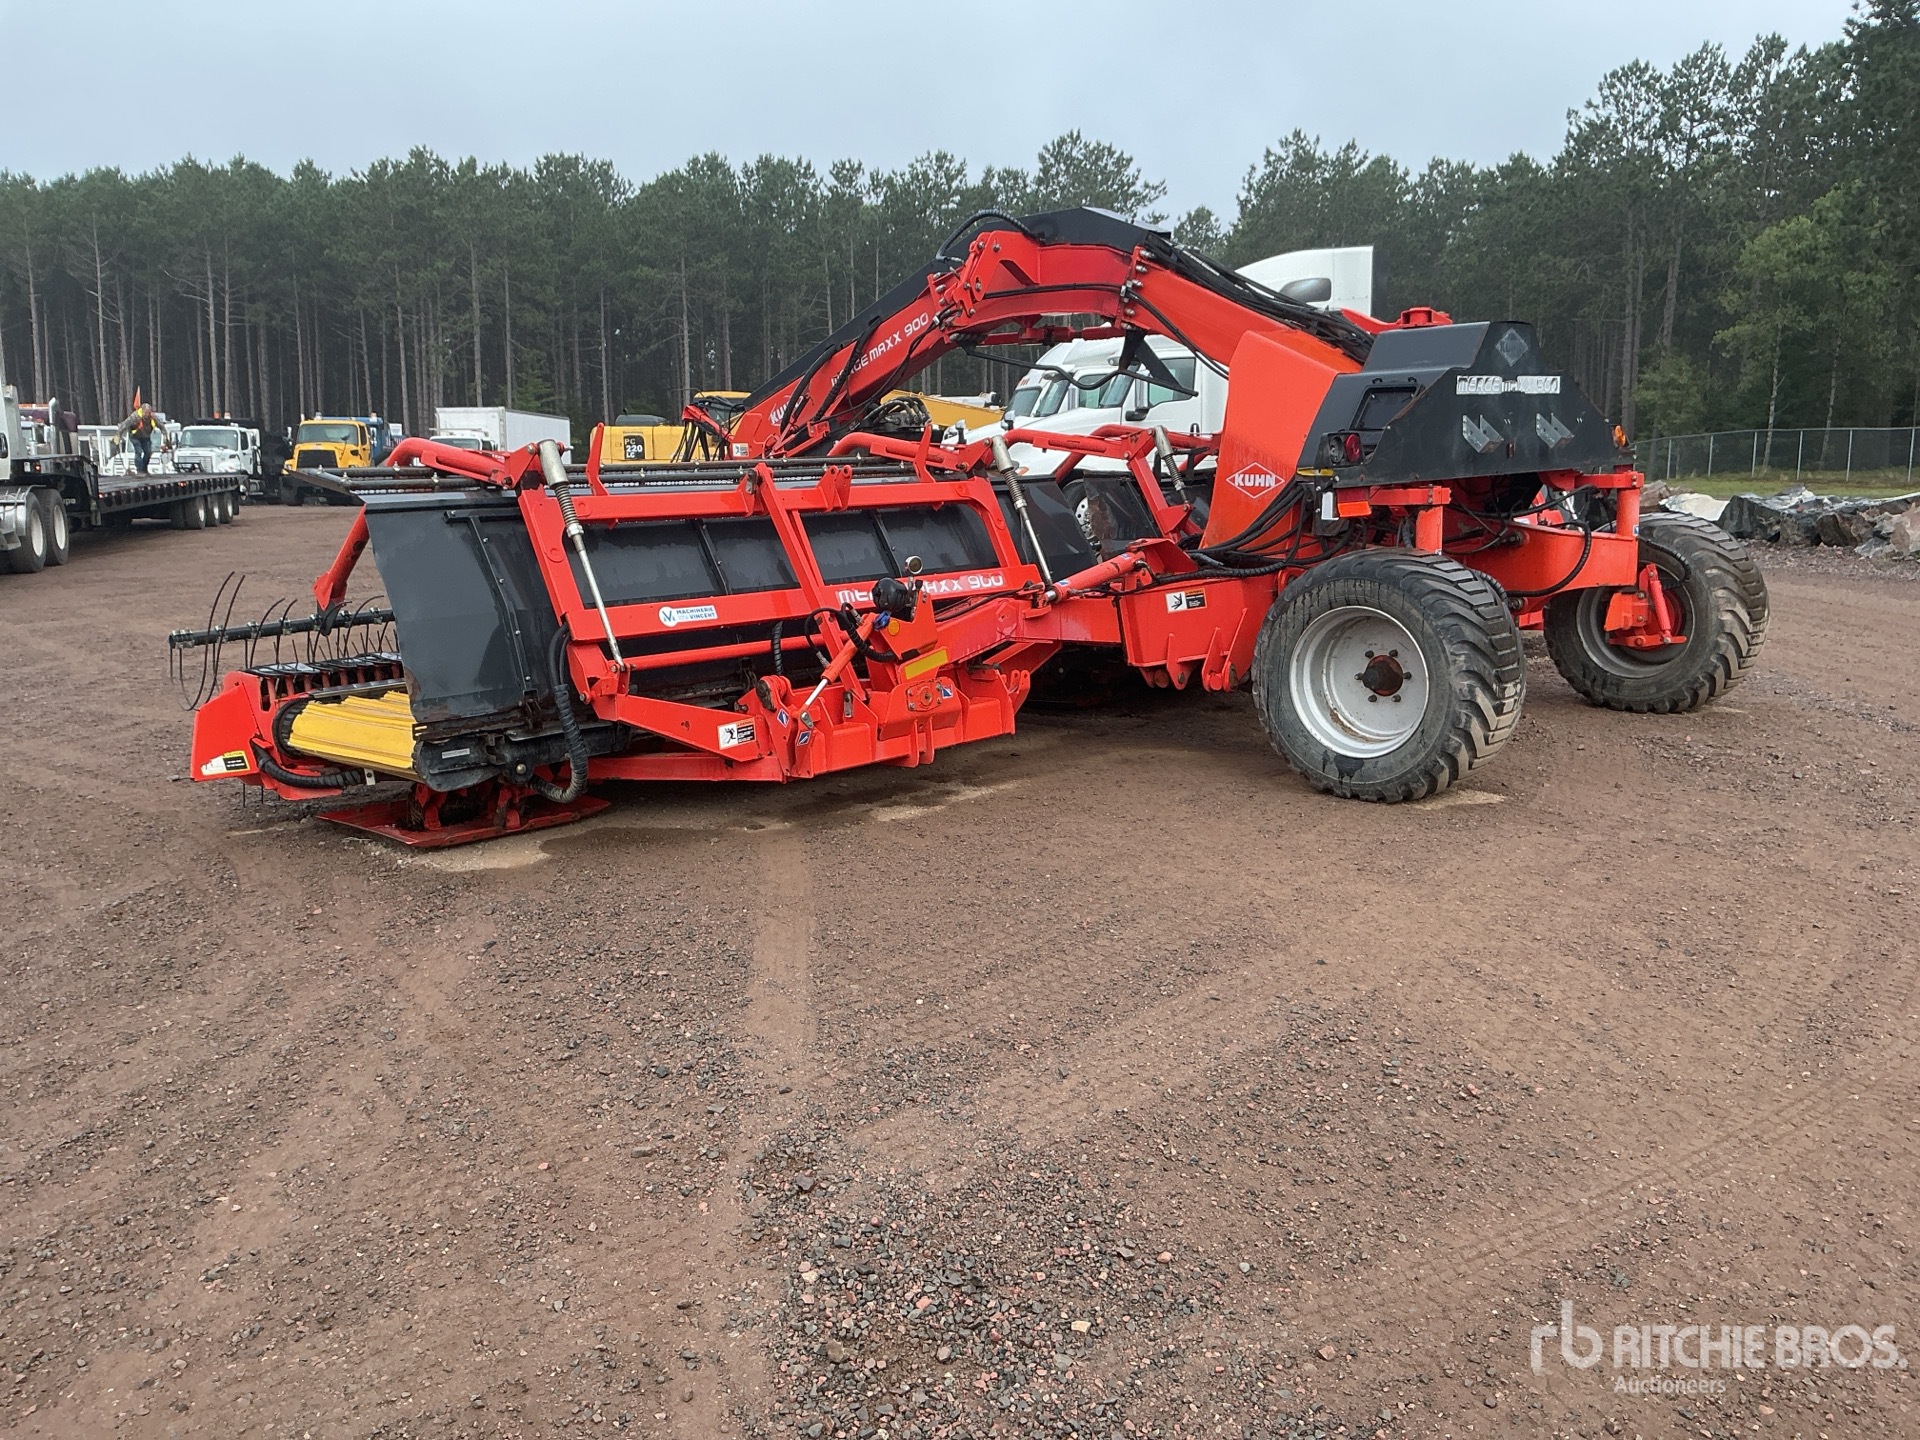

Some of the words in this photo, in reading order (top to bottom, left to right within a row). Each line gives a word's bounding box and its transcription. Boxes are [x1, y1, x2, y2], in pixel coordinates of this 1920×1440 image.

[869, 331, 902, 361] MAXX
[904, 312, 929, 338] 900
[625, 445, 643, 453] 220
[1234, 473, 1276, 487] KUHN
[676, 606, 714, 615] MACHINERIE
[689, 612, 715, 620] VINCENT
